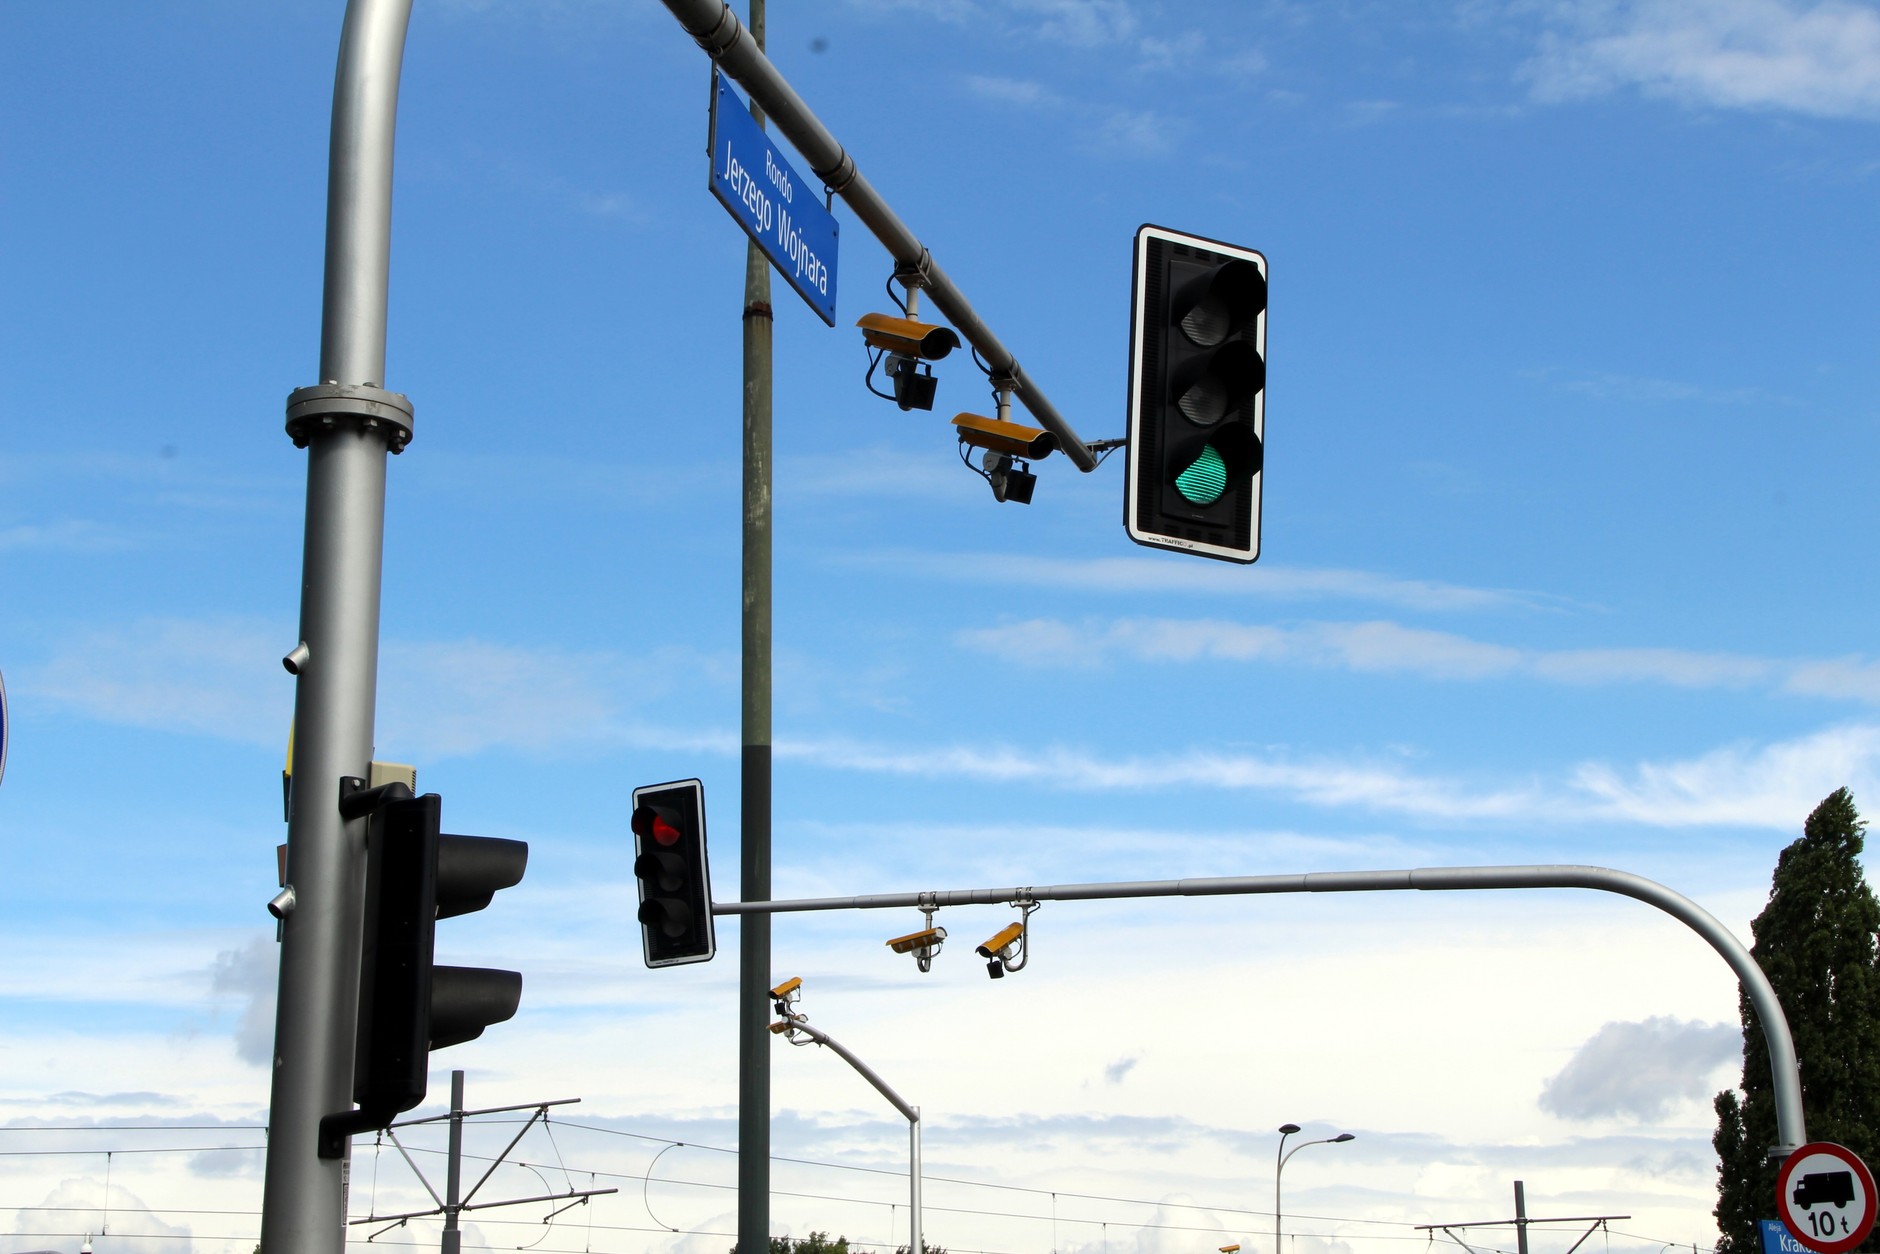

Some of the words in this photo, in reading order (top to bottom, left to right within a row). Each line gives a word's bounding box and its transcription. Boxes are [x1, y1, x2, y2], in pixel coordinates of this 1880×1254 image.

[765, 149, 793, 204] Rondo
[724, 140, 772, 233] Jerzego
[778, 203, 827, 297] Wojnara
[1768, 1223, 1782, 1234] Aleja
[1808, 1211, 1835, 1237] 10
[1840, 1216, 1850, 1234] t
